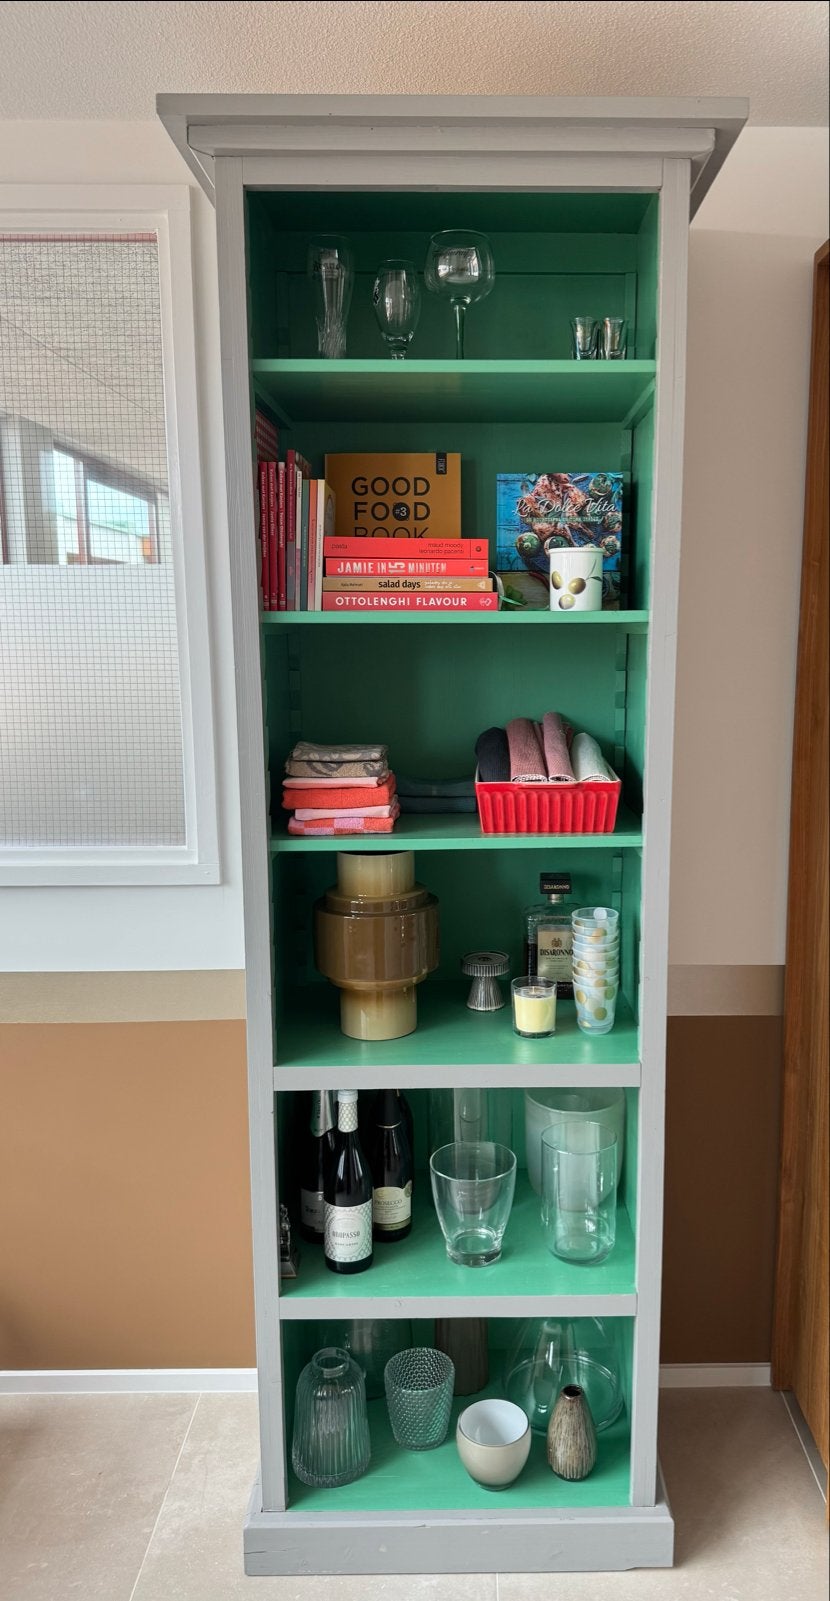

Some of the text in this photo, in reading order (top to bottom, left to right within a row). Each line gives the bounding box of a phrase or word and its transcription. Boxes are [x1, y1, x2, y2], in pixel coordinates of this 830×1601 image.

[351, 476, 430, 496] GOOD
[394, 506, 407, 517] #3
[512, 497, 617, 517] La Dolce Vita
[337, 562, 374, 574] JAMIE
[378, 562, 387, 574] IN
[408, 562, 447, 574] MINUTEN
[378, 579, 400, 588] salad
[402, 580, 421, 590] days
[335, 596, 467, 606] OTTOLENGHI FLAVOUR
[539, 948, 574, 957] DISARONNO
